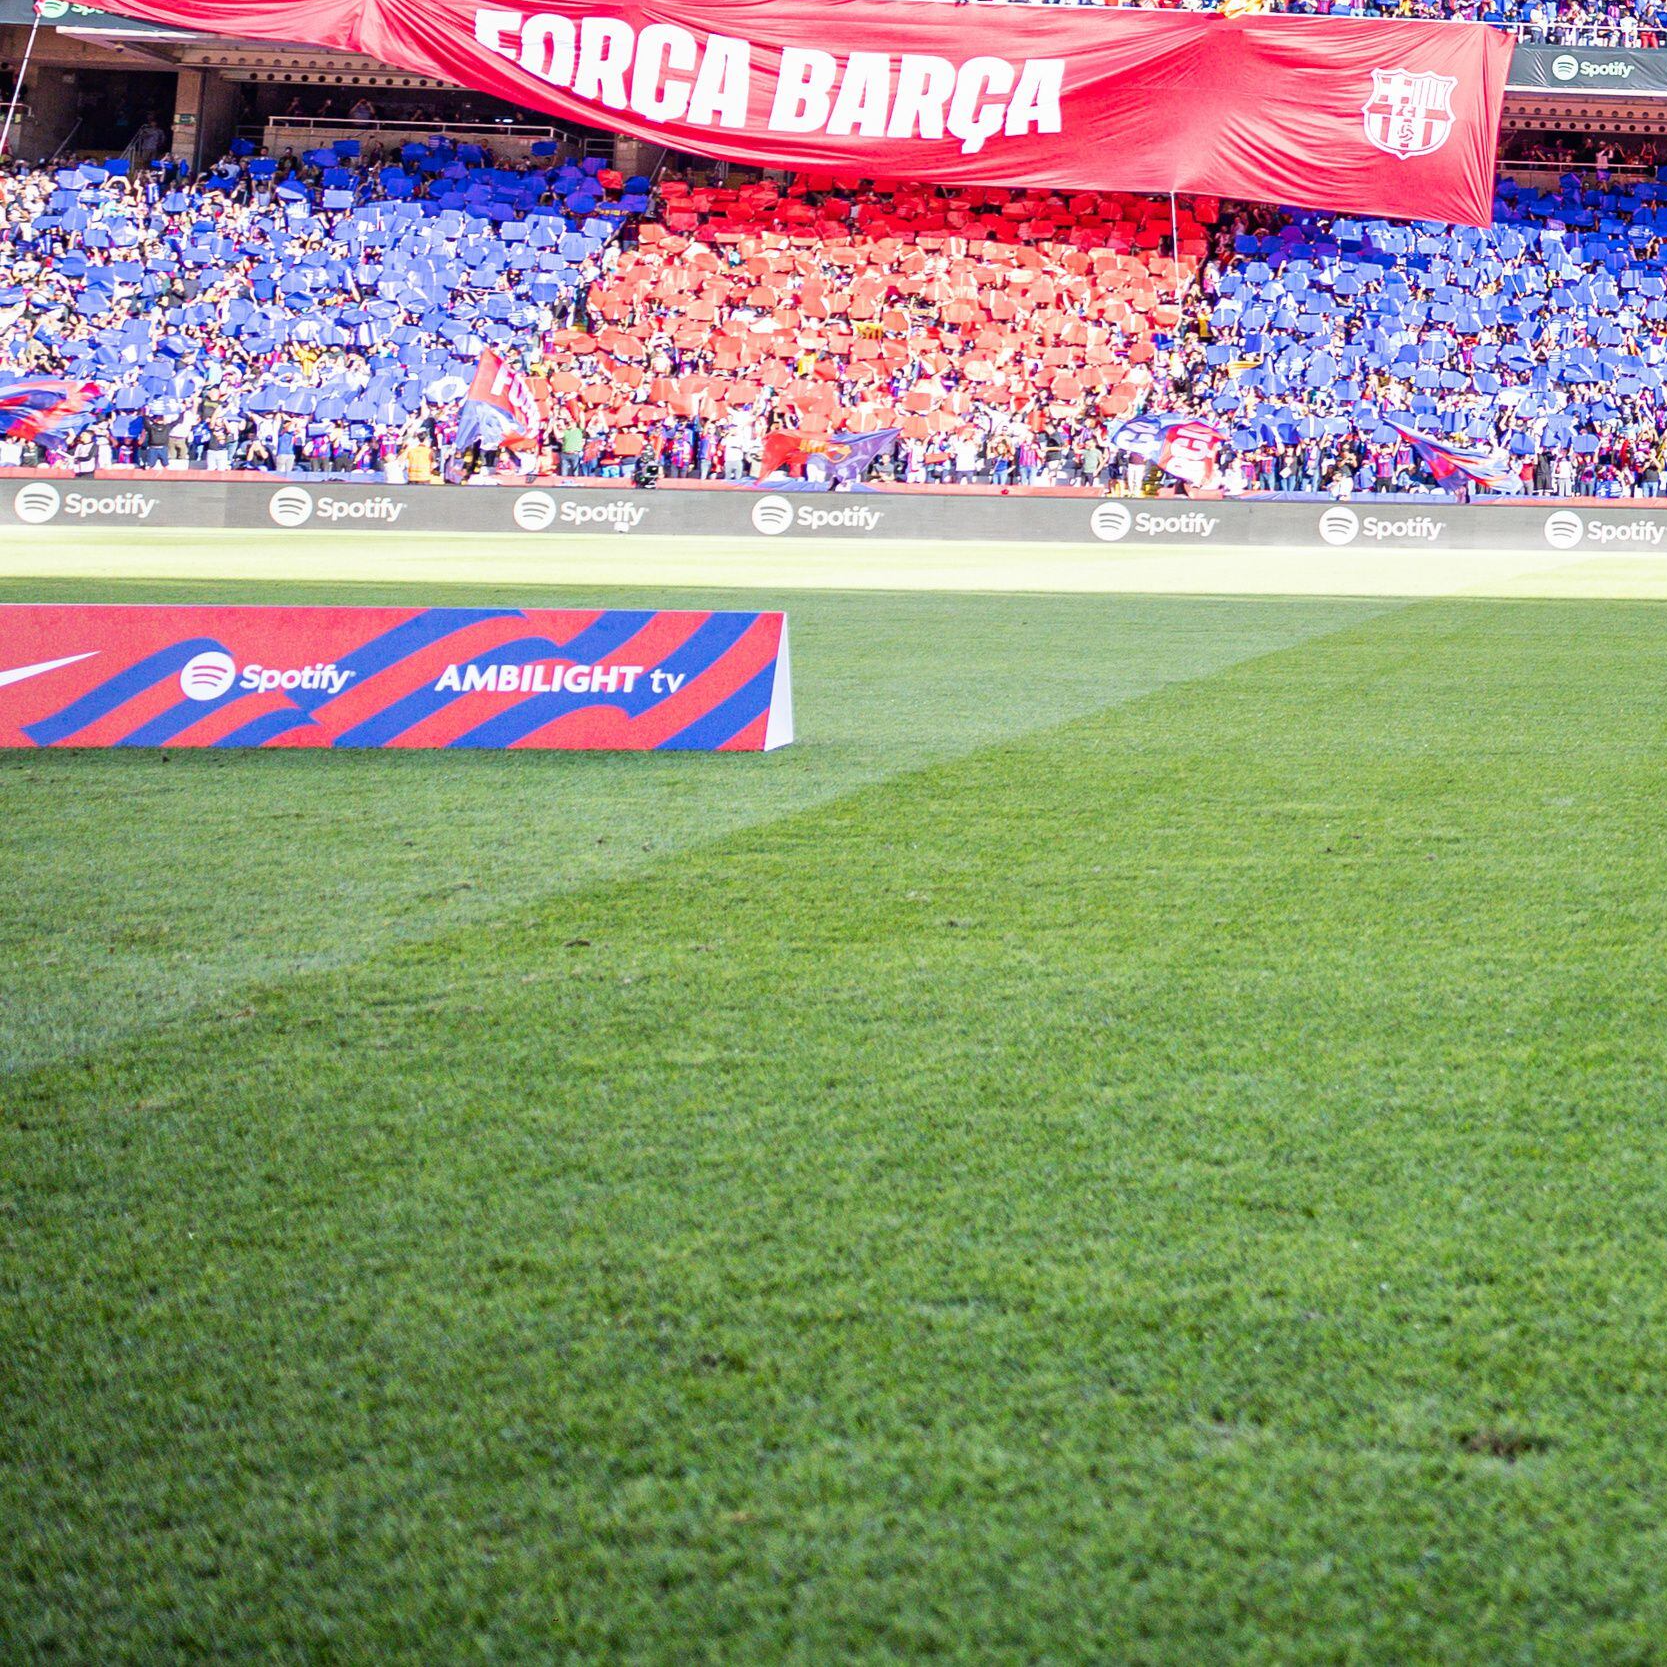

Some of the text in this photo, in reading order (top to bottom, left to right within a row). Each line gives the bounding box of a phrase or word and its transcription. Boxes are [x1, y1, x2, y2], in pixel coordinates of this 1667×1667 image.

[1580, 61, 1633, 78] Spotify
[767, 47, 1065, 154] BARÇA
[64, 492, 155, 519] Spotify
[316, 497, 403, 523] Spotify
[560, 501, 645, 526] Spotify
[797, 505, 881, 531] Spotify
[1135, 512, 1217, 537] Spotify
[1362, 516, 1443, 541] Spotify
[1587, 520, 1666, 545] Spotify
[240, 663, 686, 694] Spotify AMBILIGHT tv
